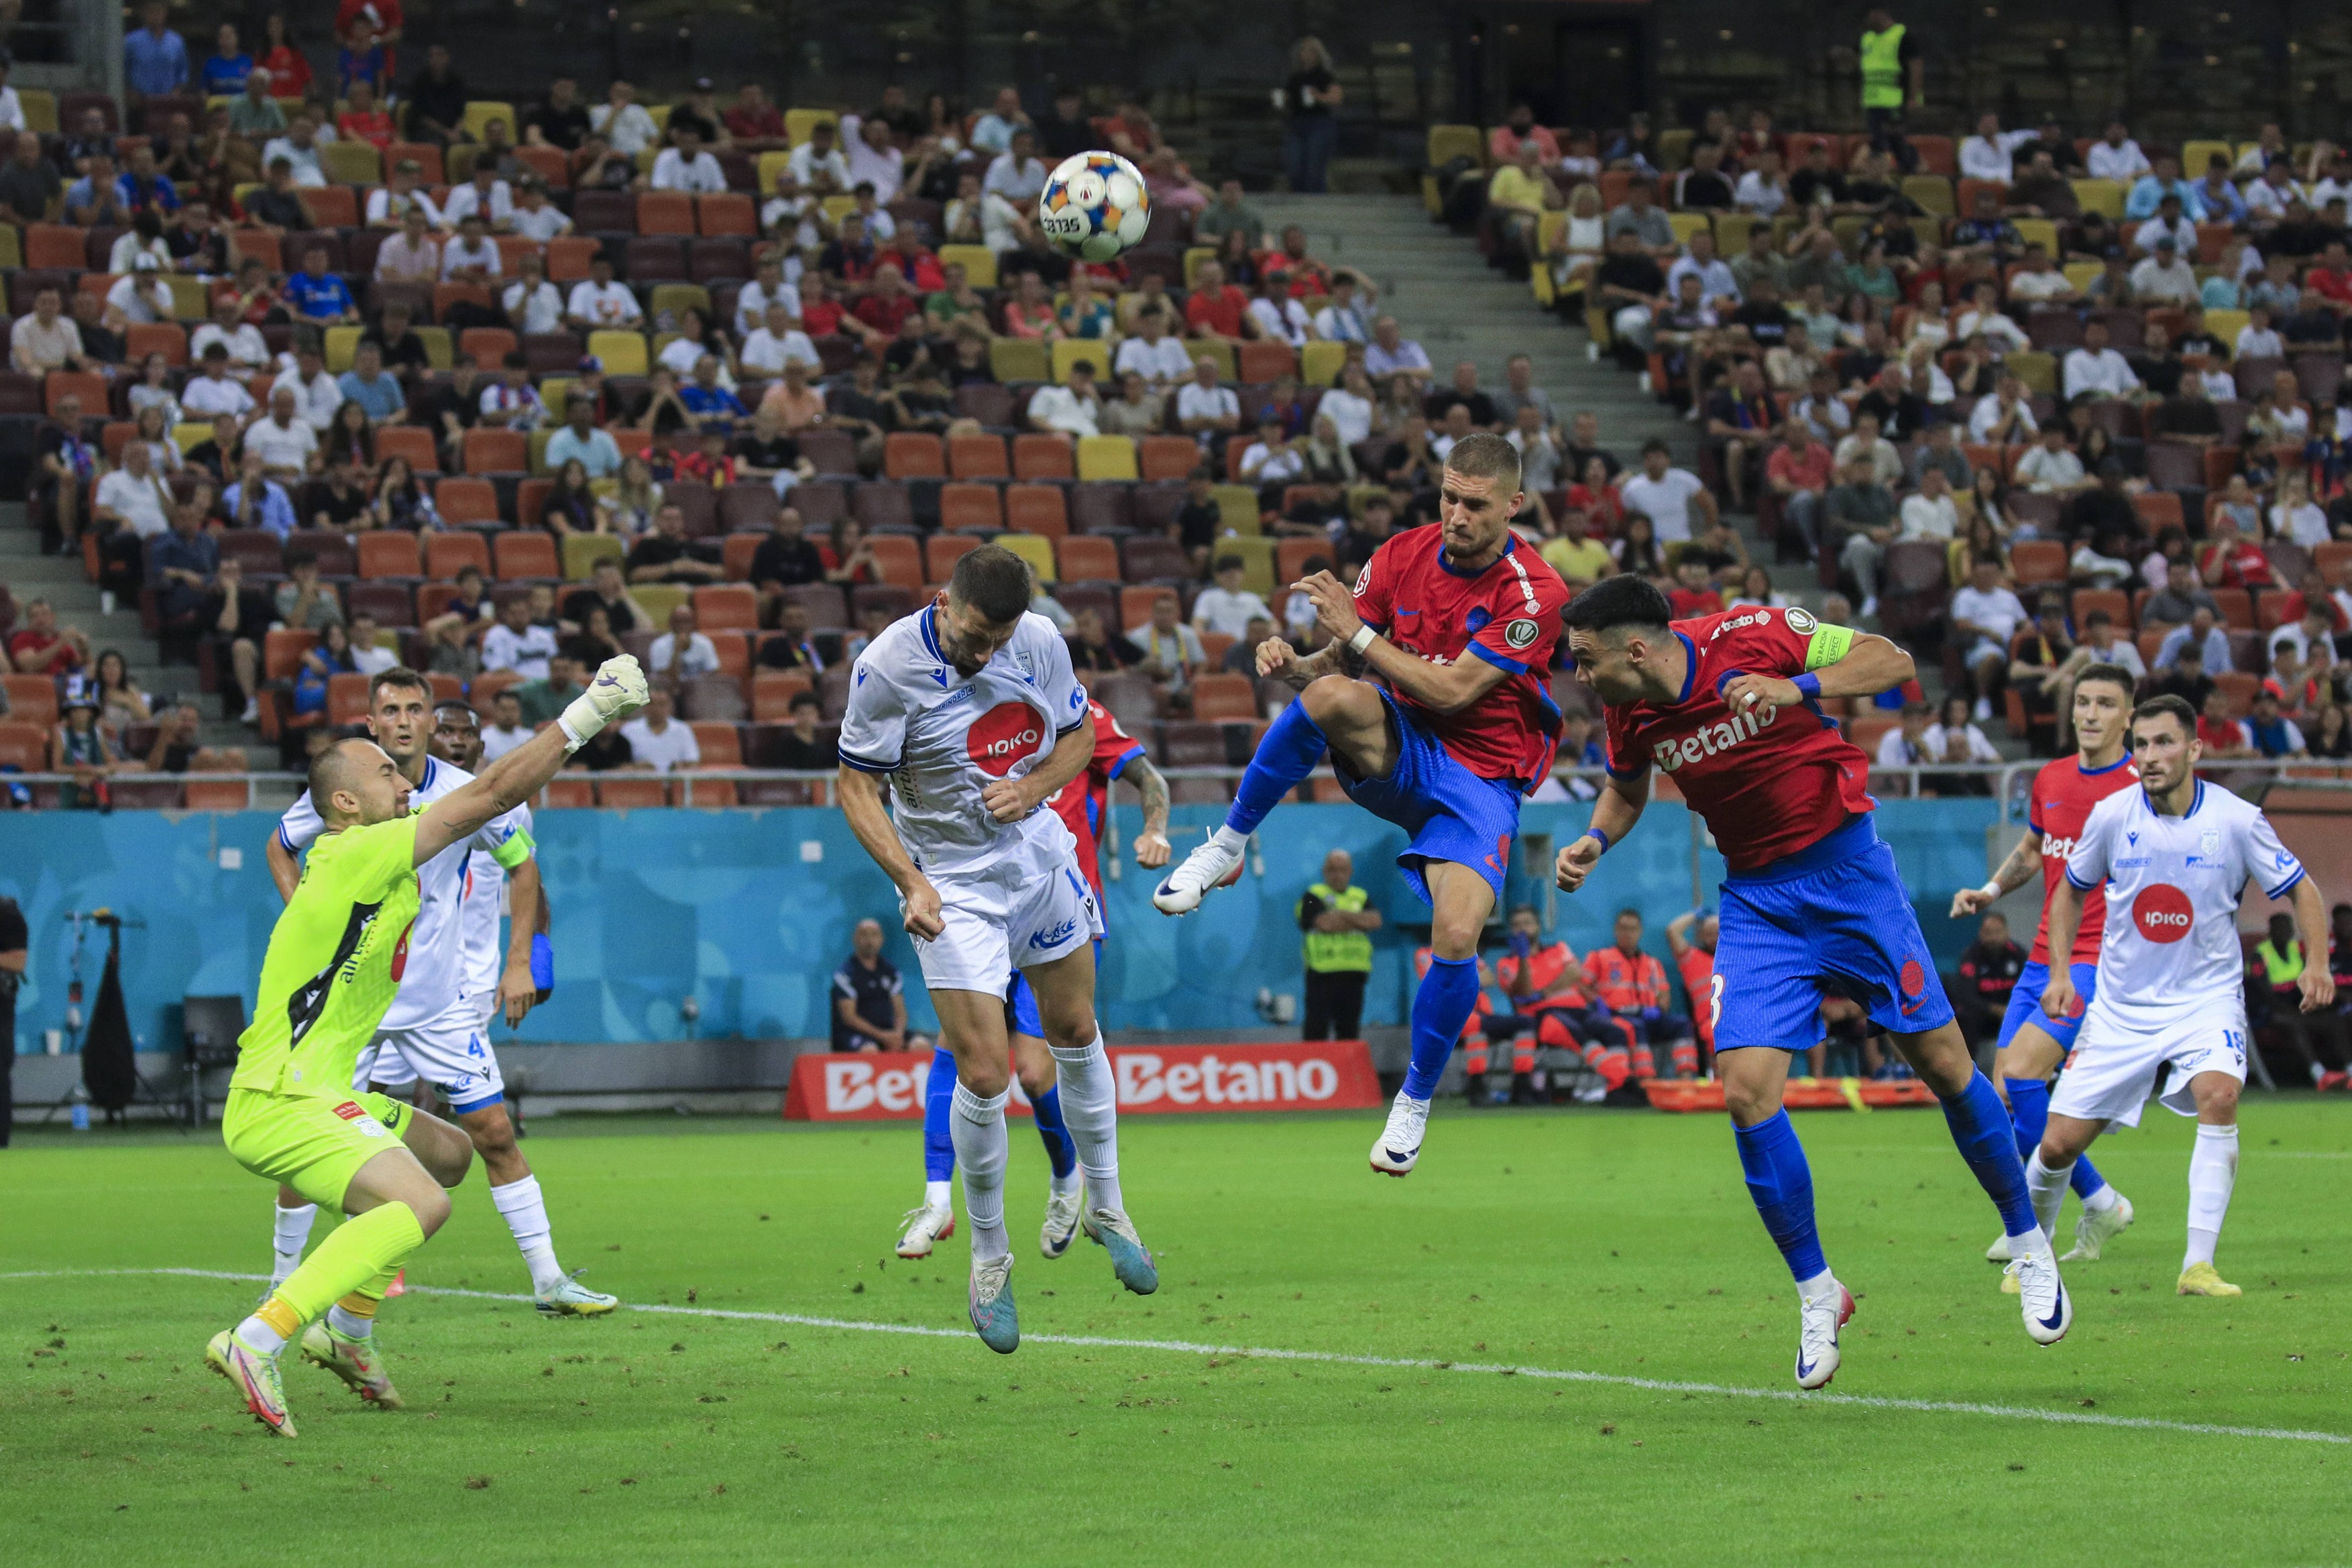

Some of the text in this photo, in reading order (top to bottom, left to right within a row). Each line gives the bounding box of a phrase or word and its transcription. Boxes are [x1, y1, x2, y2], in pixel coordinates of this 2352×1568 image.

[1653, 705, 1777, 771] Betano
[2041, 832, 2074, 860] Bet
[468, 1032, 486, 1058] 4
[1116, 1054, 1339, 1105] Betano
